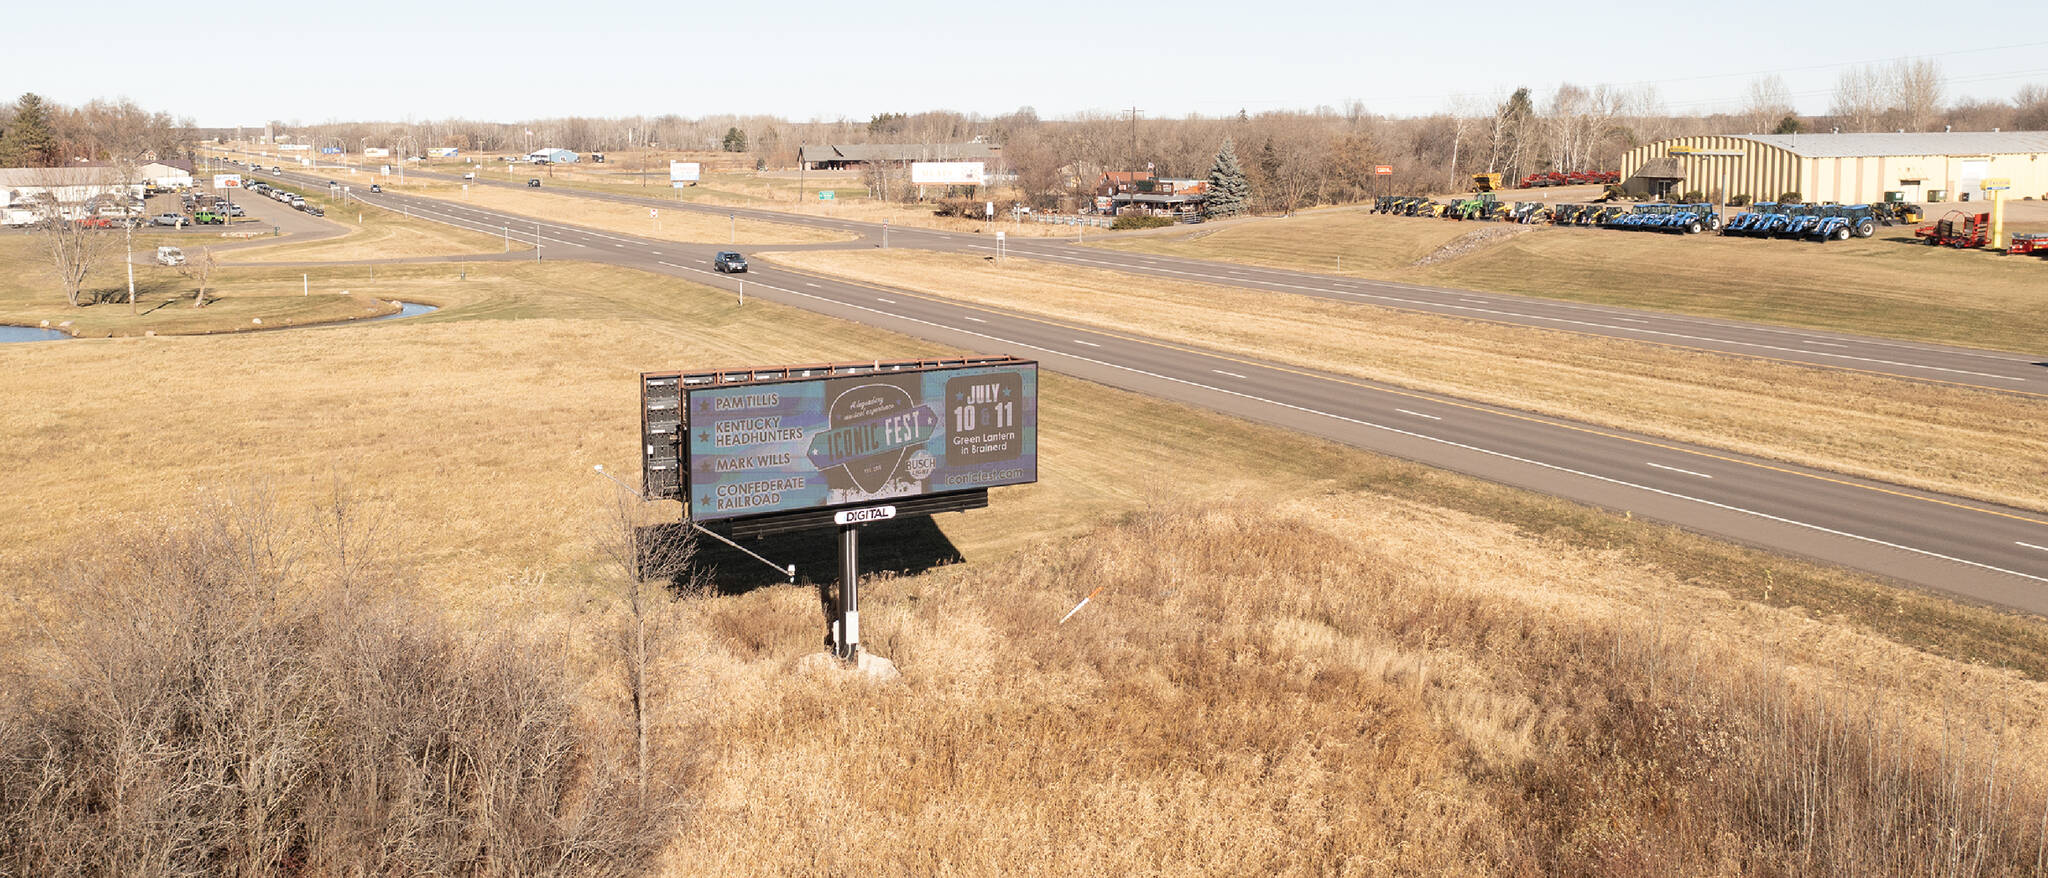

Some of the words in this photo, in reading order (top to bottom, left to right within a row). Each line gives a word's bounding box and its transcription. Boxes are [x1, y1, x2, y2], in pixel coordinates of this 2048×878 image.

[716, 397, 743, 410] PAM
[747, 394, 778, 407] TILLIS
[967, 384, 1000, 405] JULY
[716, 417, 780, 433] KENTUCKY
[954, 405, 976, 432] 10
[995, 402, 1013, 428] 11
[716, 428, 803, 447] HEADHUNTERS
[827, 422, 879, 462] ICONIC
[885, 411, 919, 446] FEST
[953, 434, 981, 445] Green
[983, 431, 1015, 443] Lantern
[961, 446, 969, 455] in
[971, 442, 1007, 454] Brainerd
[717, 457, 754, 471] MARK
[757, 453, 791, 467] WILLS
[906, 457, 937, 471] BUSCH
[717, 478, 805, 496] CONFEDERATE
[717, 493, 780, 510] RAILROAD
[846, 508, 888, 522] DIGITAL
